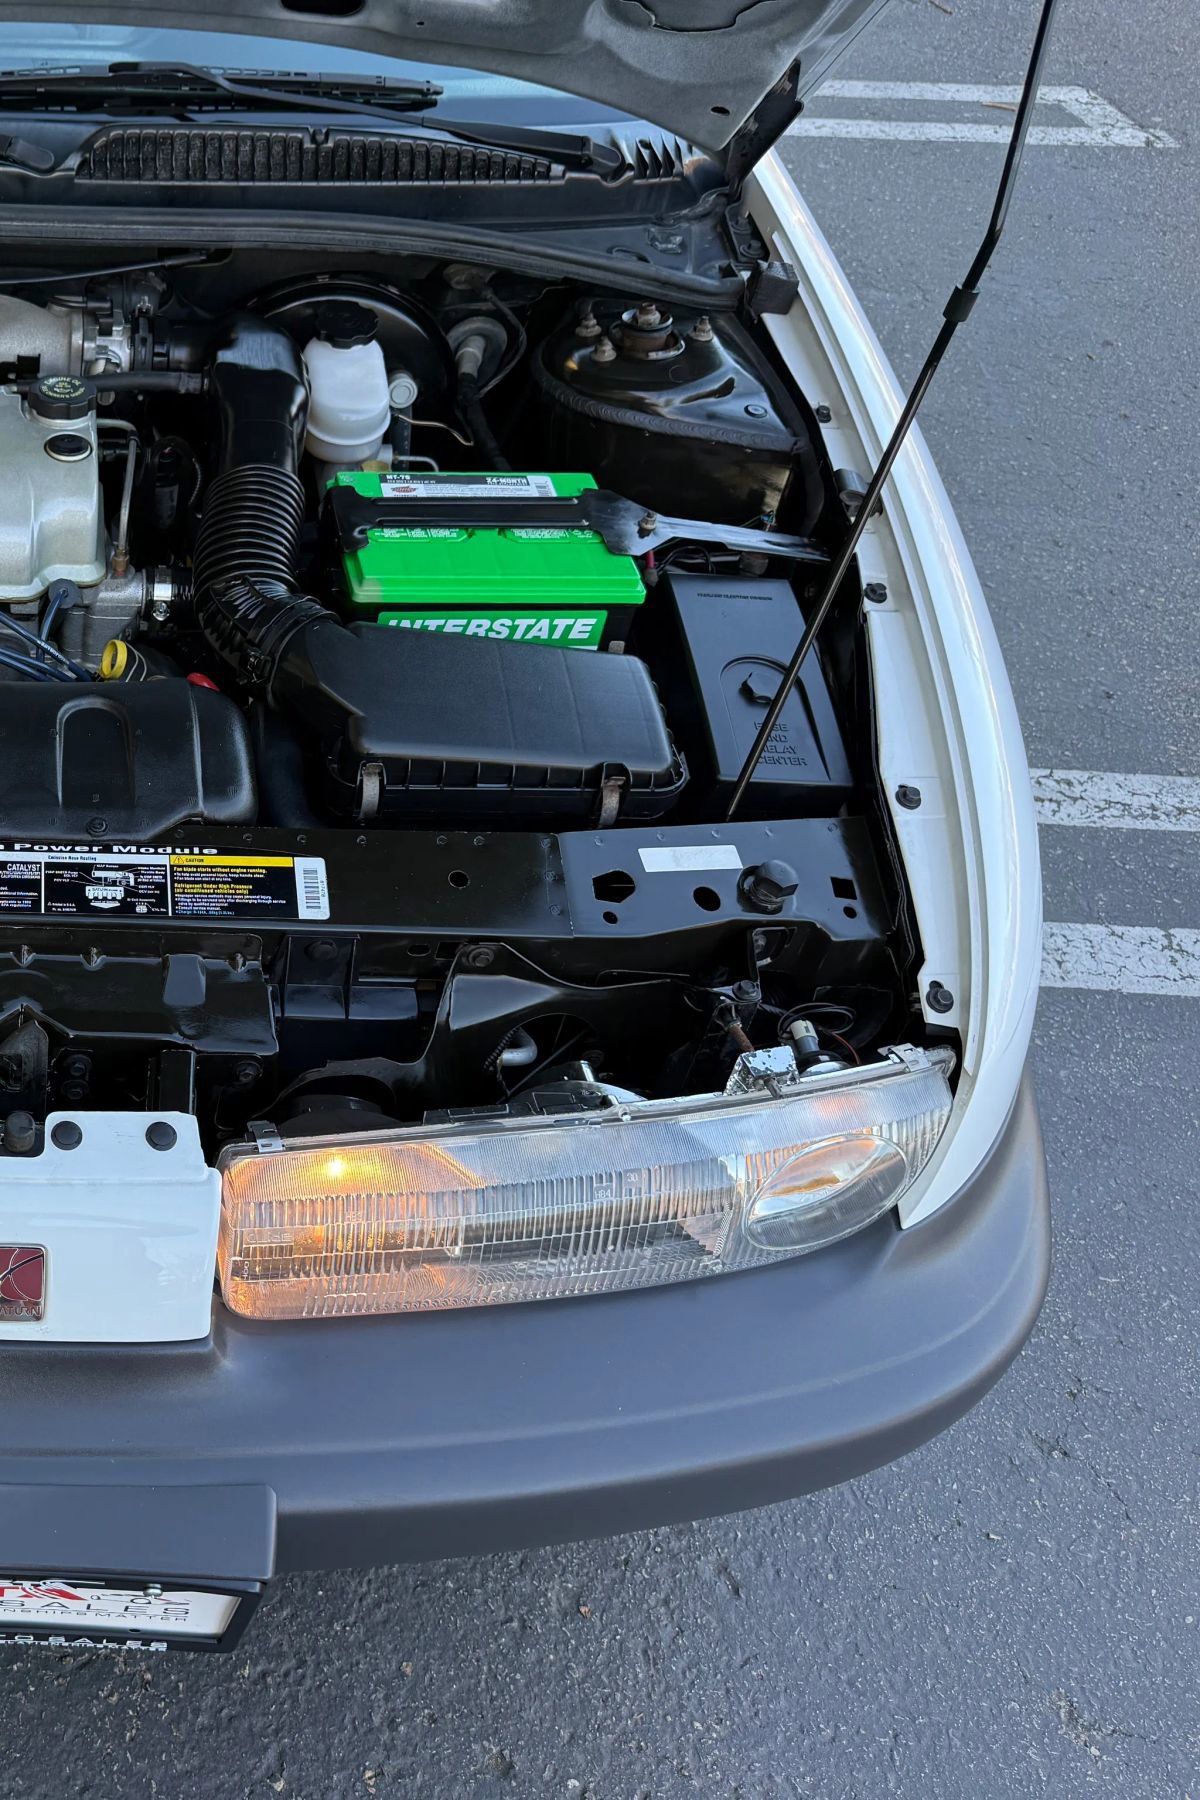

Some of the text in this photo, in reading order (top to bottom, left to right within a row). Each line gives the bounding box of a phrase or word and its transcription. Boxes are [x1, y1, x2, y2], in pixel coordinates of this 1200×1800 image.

[753, 721, 791, 732] FSE
[14, 843, 103, 853] Power
[112, 845, 218, 855] Module
[7, 863, 40, 871] CATALYST
[594, 1188, 611, 1200] HB4
[0, 1599, 190, 1616] SALES
[94, 1613, 189, 1623] MATTER
